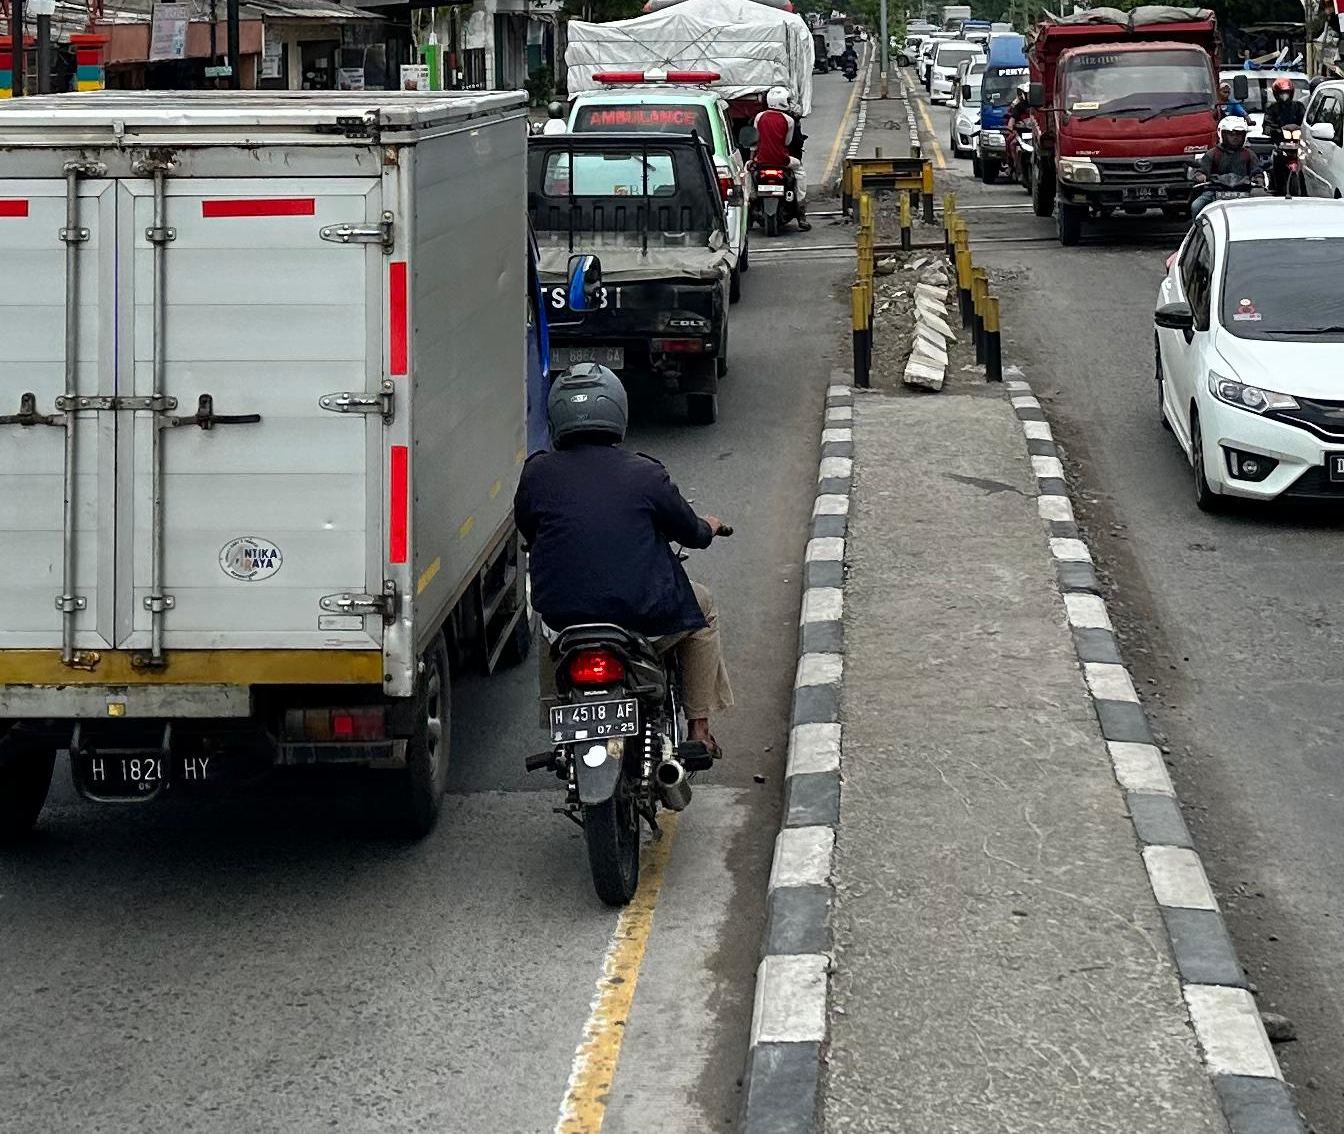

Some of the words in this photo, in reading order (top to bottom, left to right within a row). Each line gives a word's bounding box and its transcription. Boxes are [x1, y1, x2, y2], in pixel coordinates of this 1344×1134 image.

[590, 110, 695, 125] AMBULANCE
[555, 711, 563, 724] H
[572, 706, 607, 722] 4518
[616, 703, 634, 718] AF
[92, 759, 105, 781] H
[184, 757, 209, 780] HY
